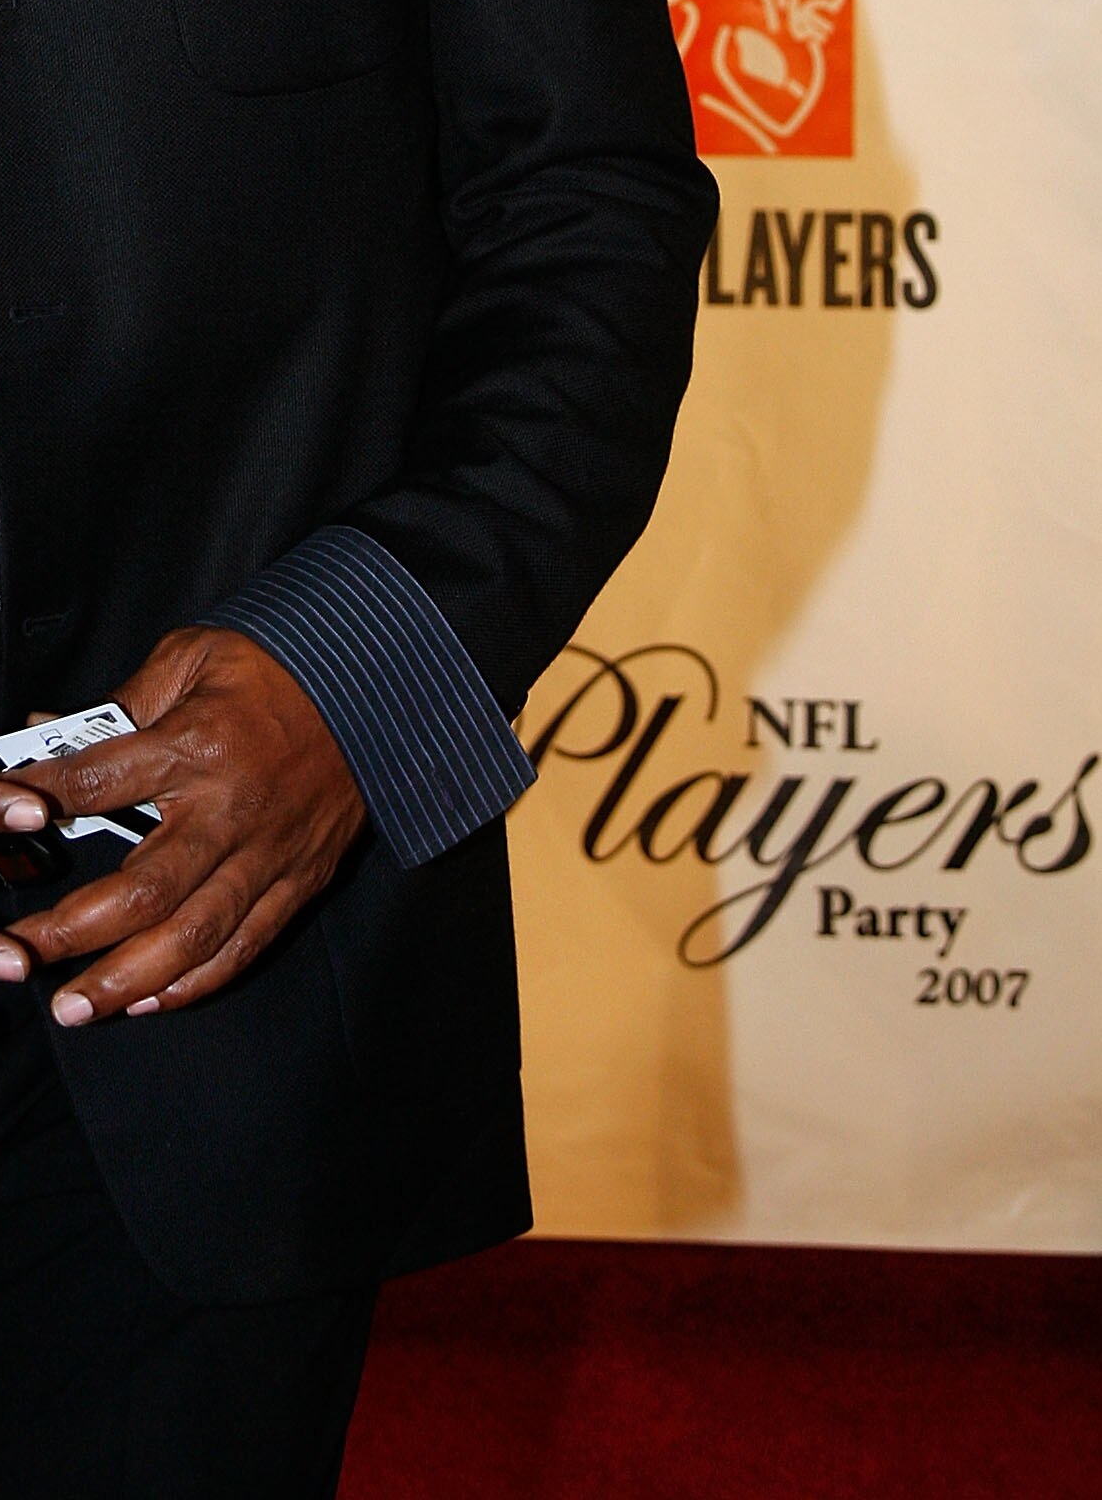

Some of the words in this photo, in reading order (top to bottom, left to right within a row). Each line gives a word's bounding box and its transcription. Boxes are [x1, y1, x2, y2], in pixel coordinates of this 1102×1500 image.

[746, 697, 880, 752] NFL
[816, 885, 968, 958] Party
[916, 968, 1031, 1010] 2007
